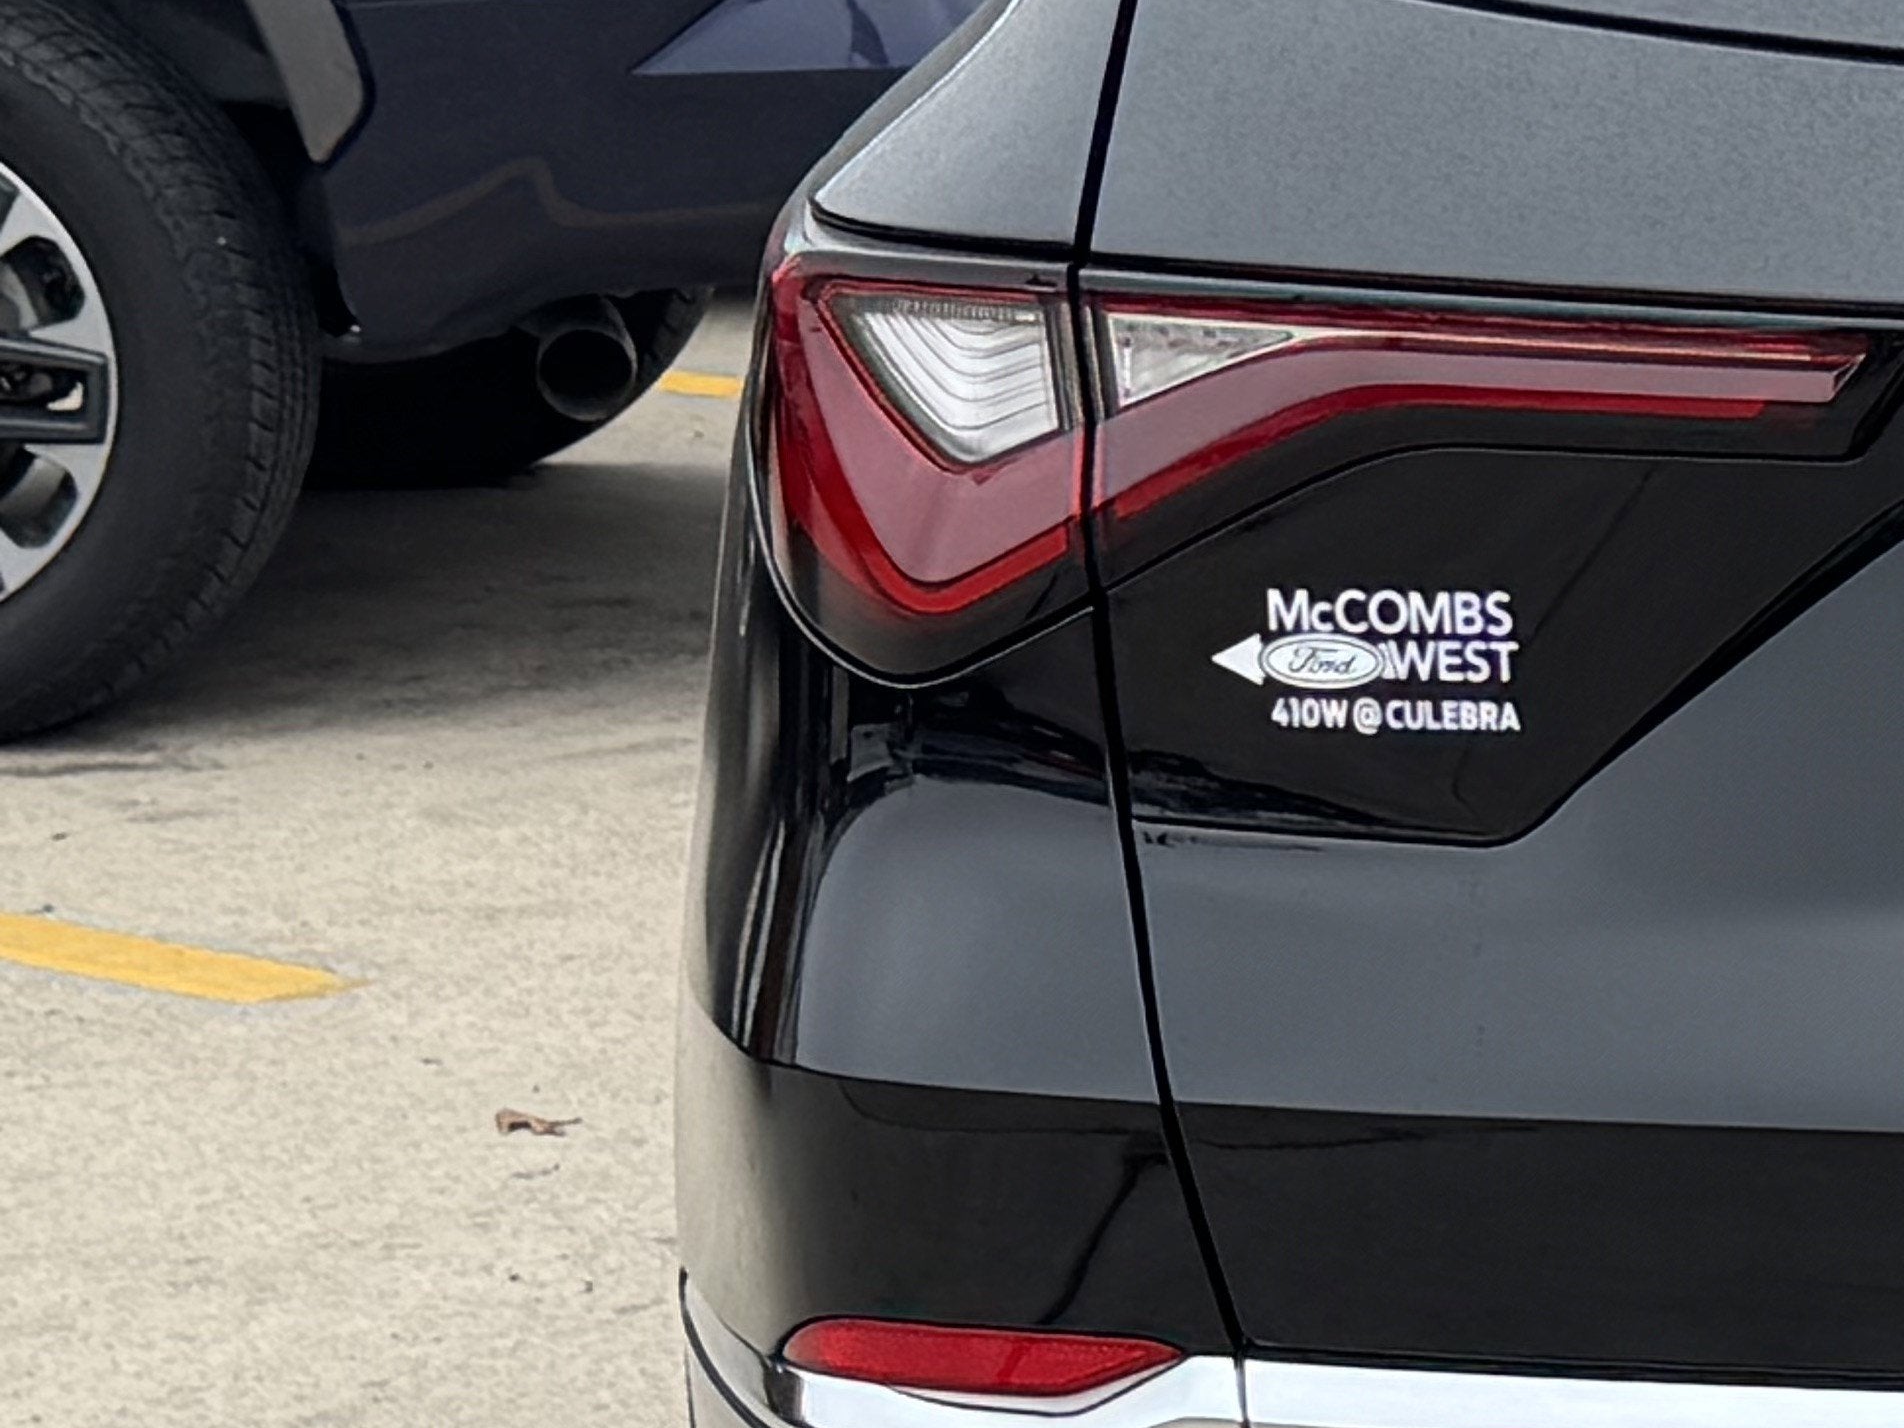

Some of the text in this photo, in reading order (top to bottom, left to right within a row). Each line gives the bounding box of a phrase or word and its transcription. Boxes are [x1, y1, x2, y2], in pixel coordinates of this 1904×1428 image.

[1266, 587, 1514, 636] McCOMBS
[1287, 639, 1520, 684] Ford WEST
